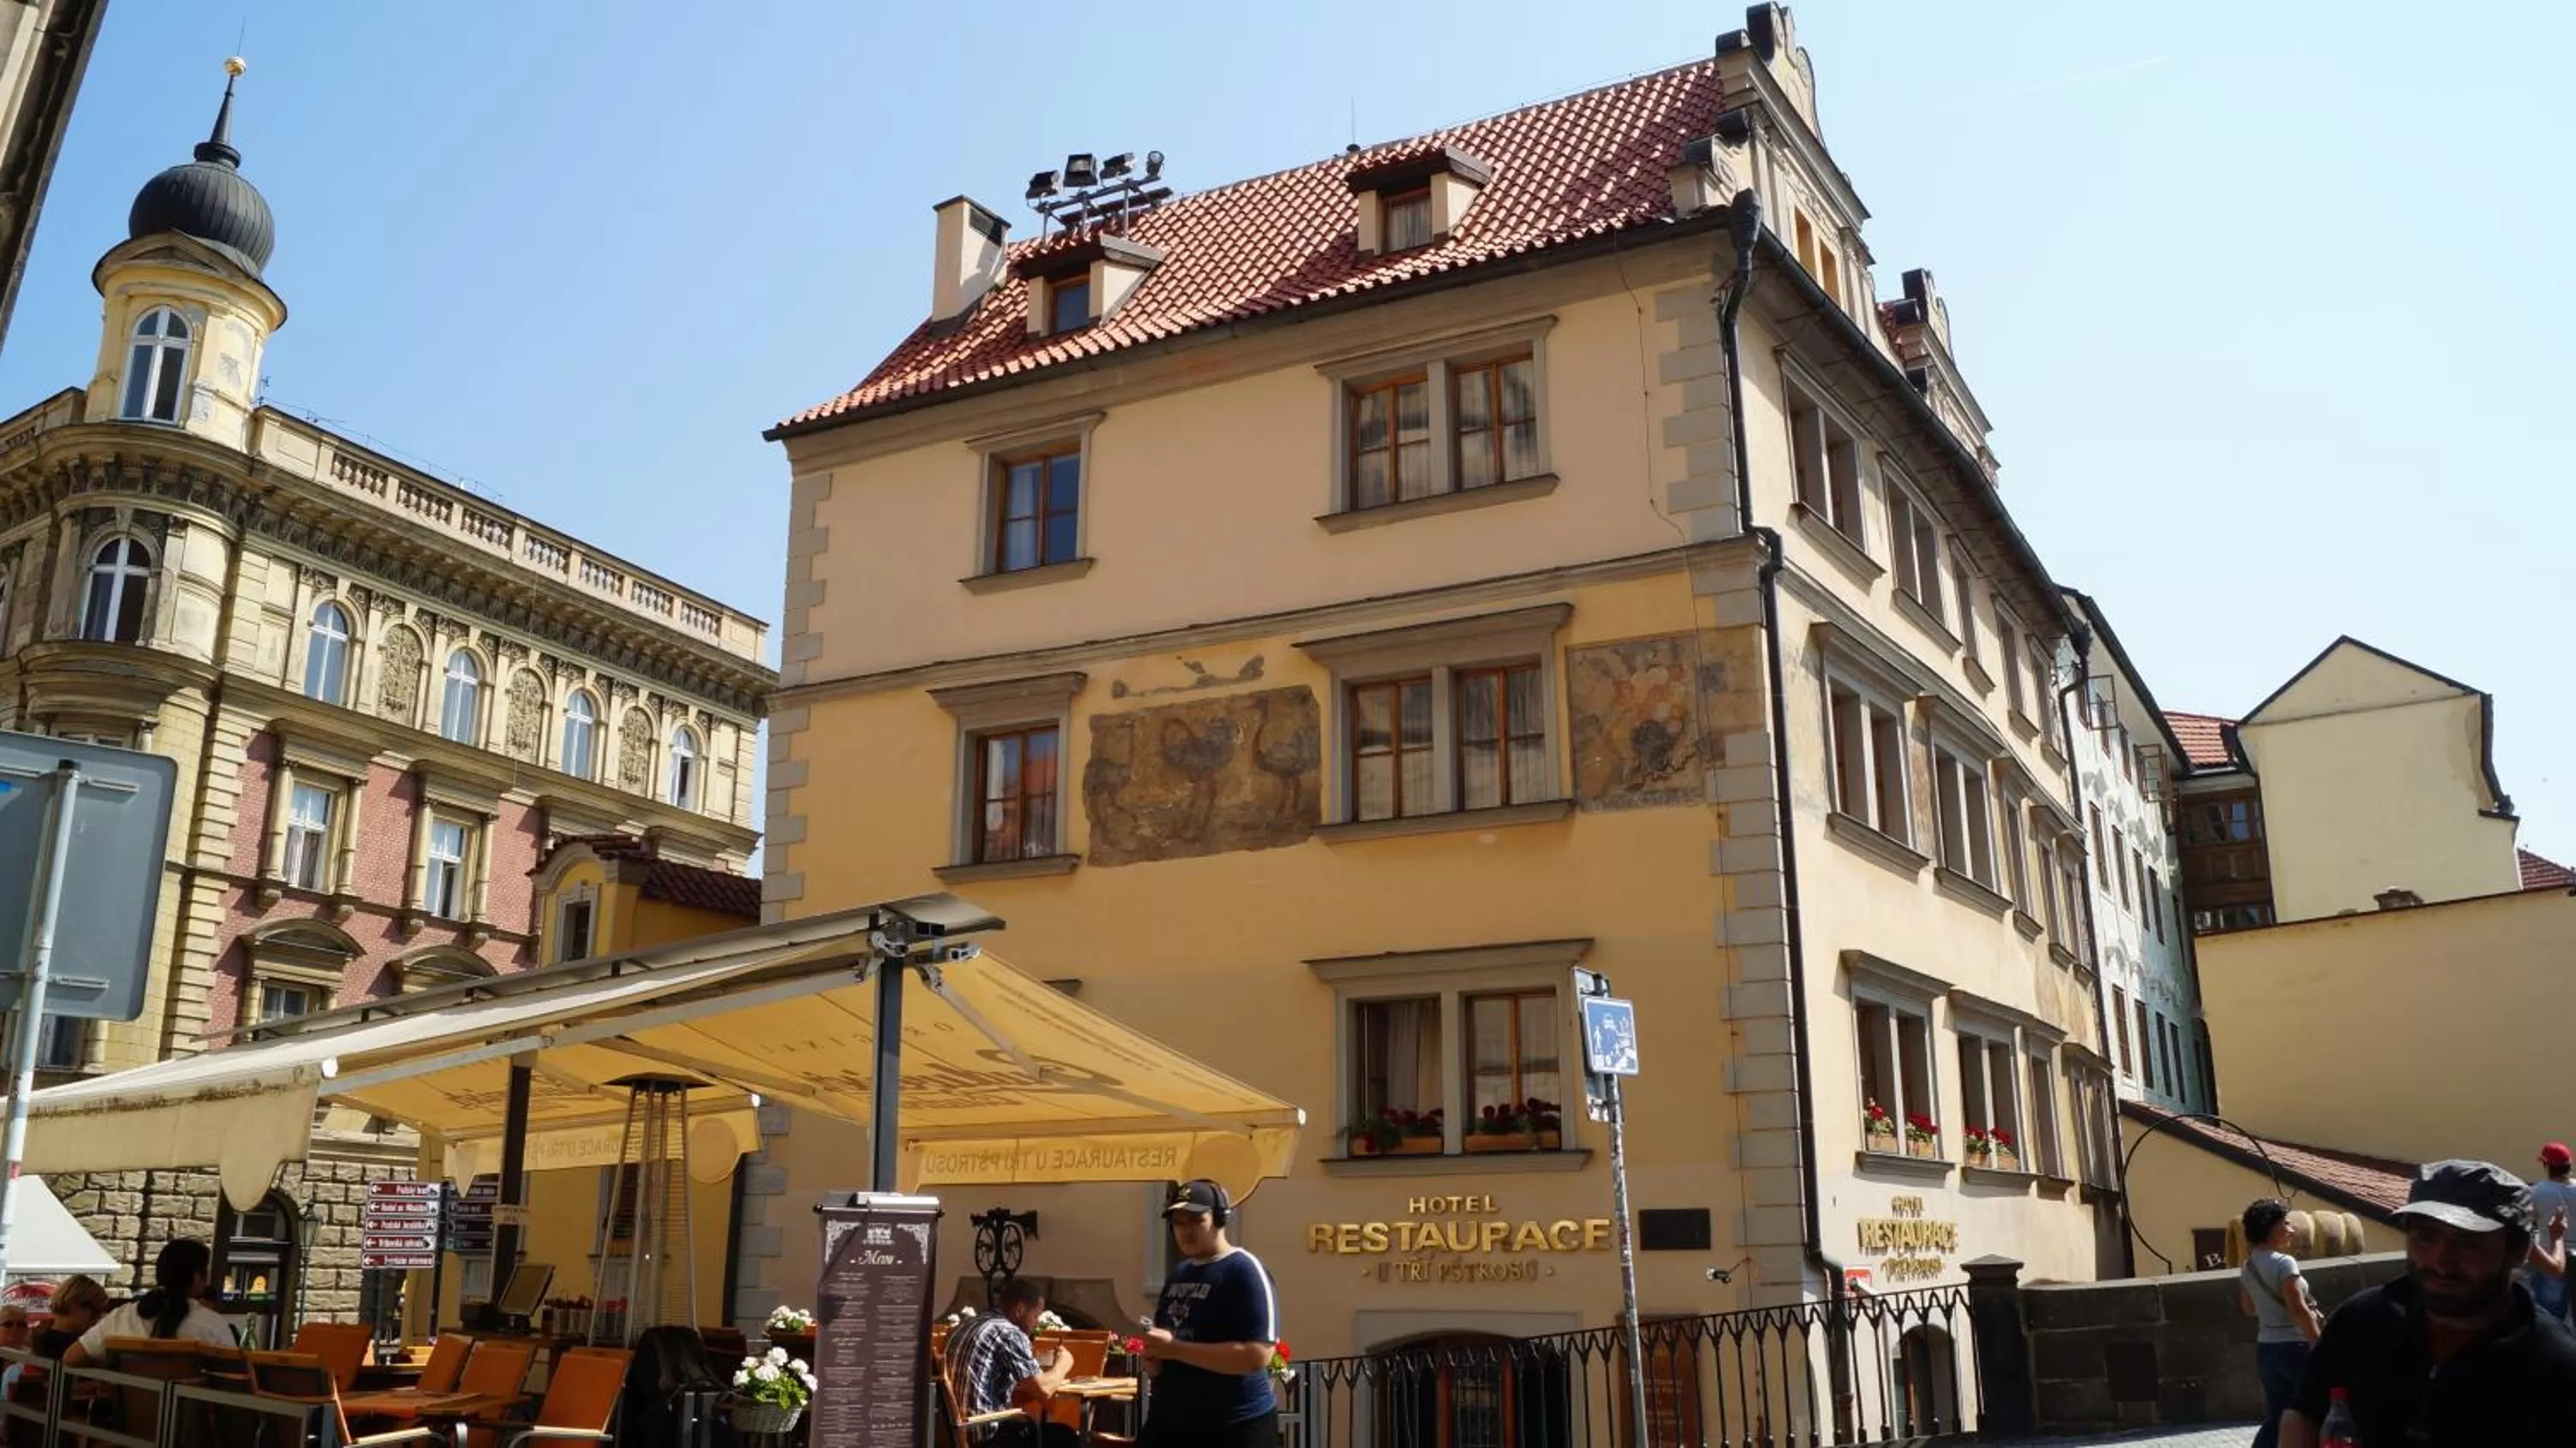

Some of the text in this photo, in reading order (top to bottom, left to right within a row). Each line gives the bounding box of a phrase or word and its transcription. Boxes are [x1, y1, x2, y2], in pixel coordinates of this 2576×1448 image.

[1408, 1195, 1498, 1214] HOTEL
[1308, 1219, 1612, 1254] RESTAURACE
[1857, 1220, 1959, 1249] RESTAURACE
